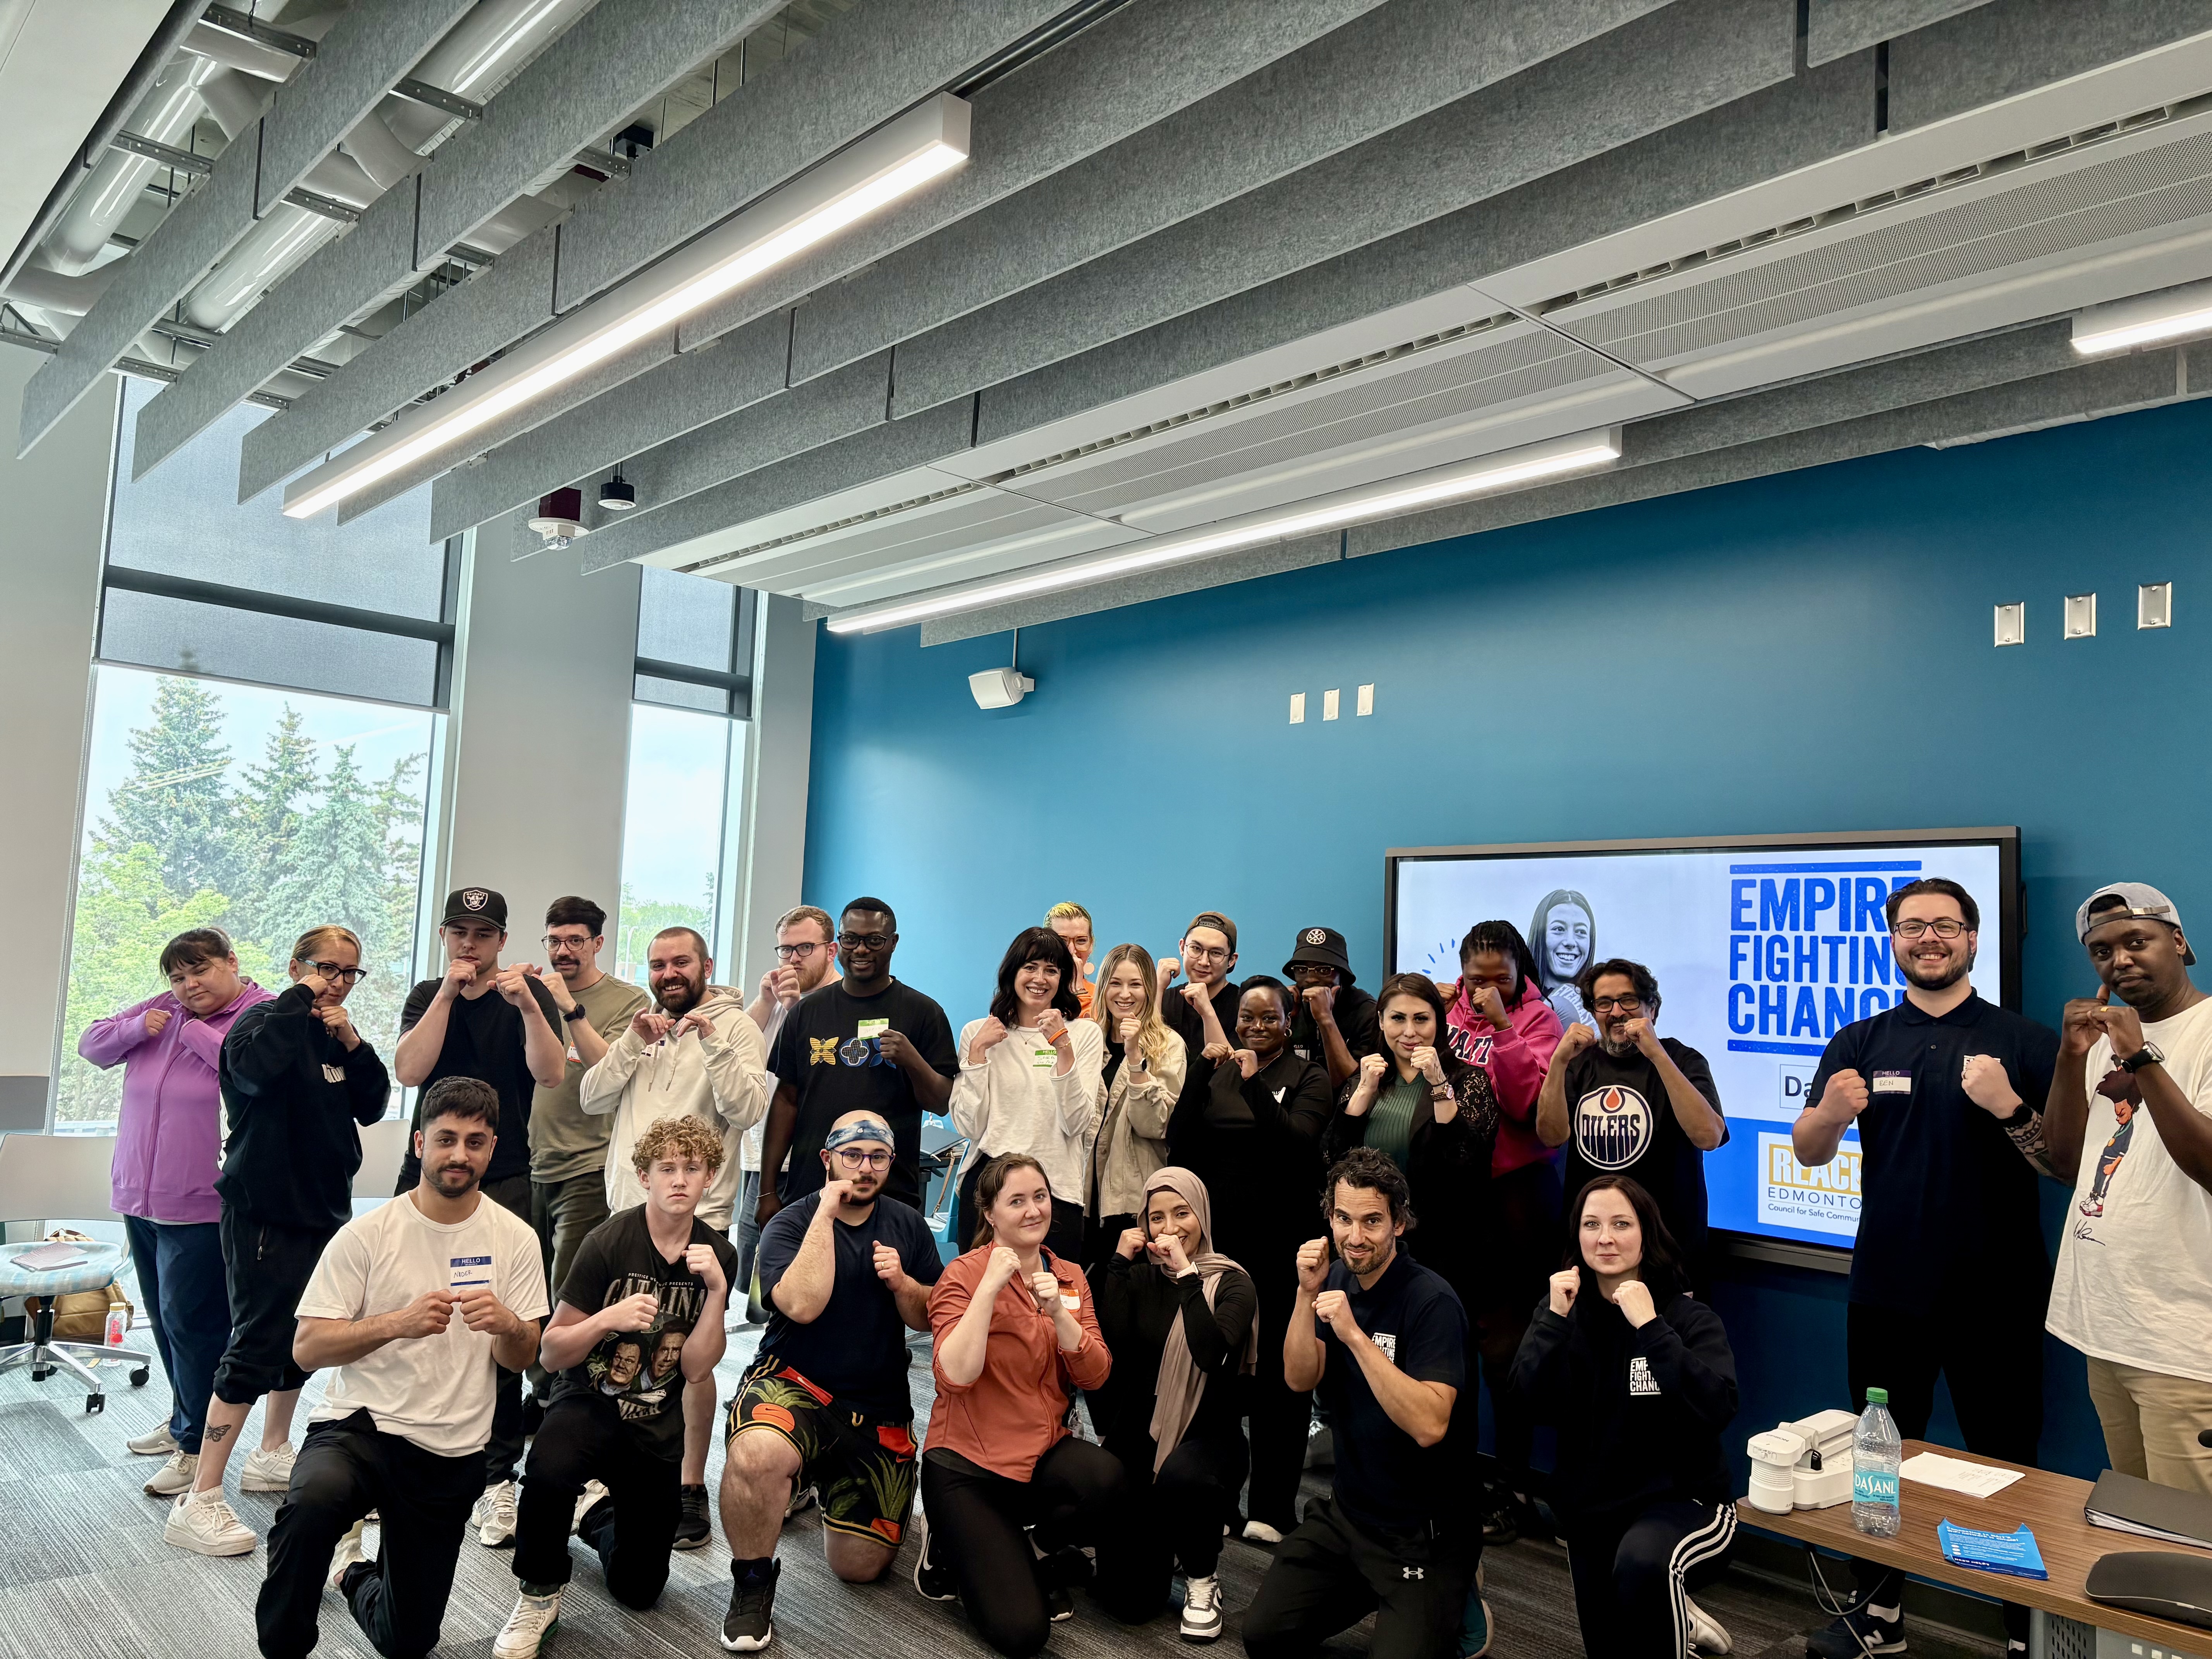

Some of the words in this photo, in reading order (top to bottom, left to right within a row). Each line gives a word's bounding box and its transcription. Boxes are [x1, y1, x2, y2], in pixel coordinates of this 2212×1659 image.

[1731, 877, 1920, 932] EMPIR
[1728, 983, 1905, 1038] CHANC
[1582, 1114, 1640, 1163] OILERS
[1768, 1187, 1862, 1209] EDMONTO
[1768, 1204, 1795, 1214] Council
[1797, 1207, 1807, 1215] for
[1809, 1209, 1824, 1218] Safe
[1630, 1381, 1660, 1392] CHANC
[1855, 1474, 1896, 1495] DASANI
